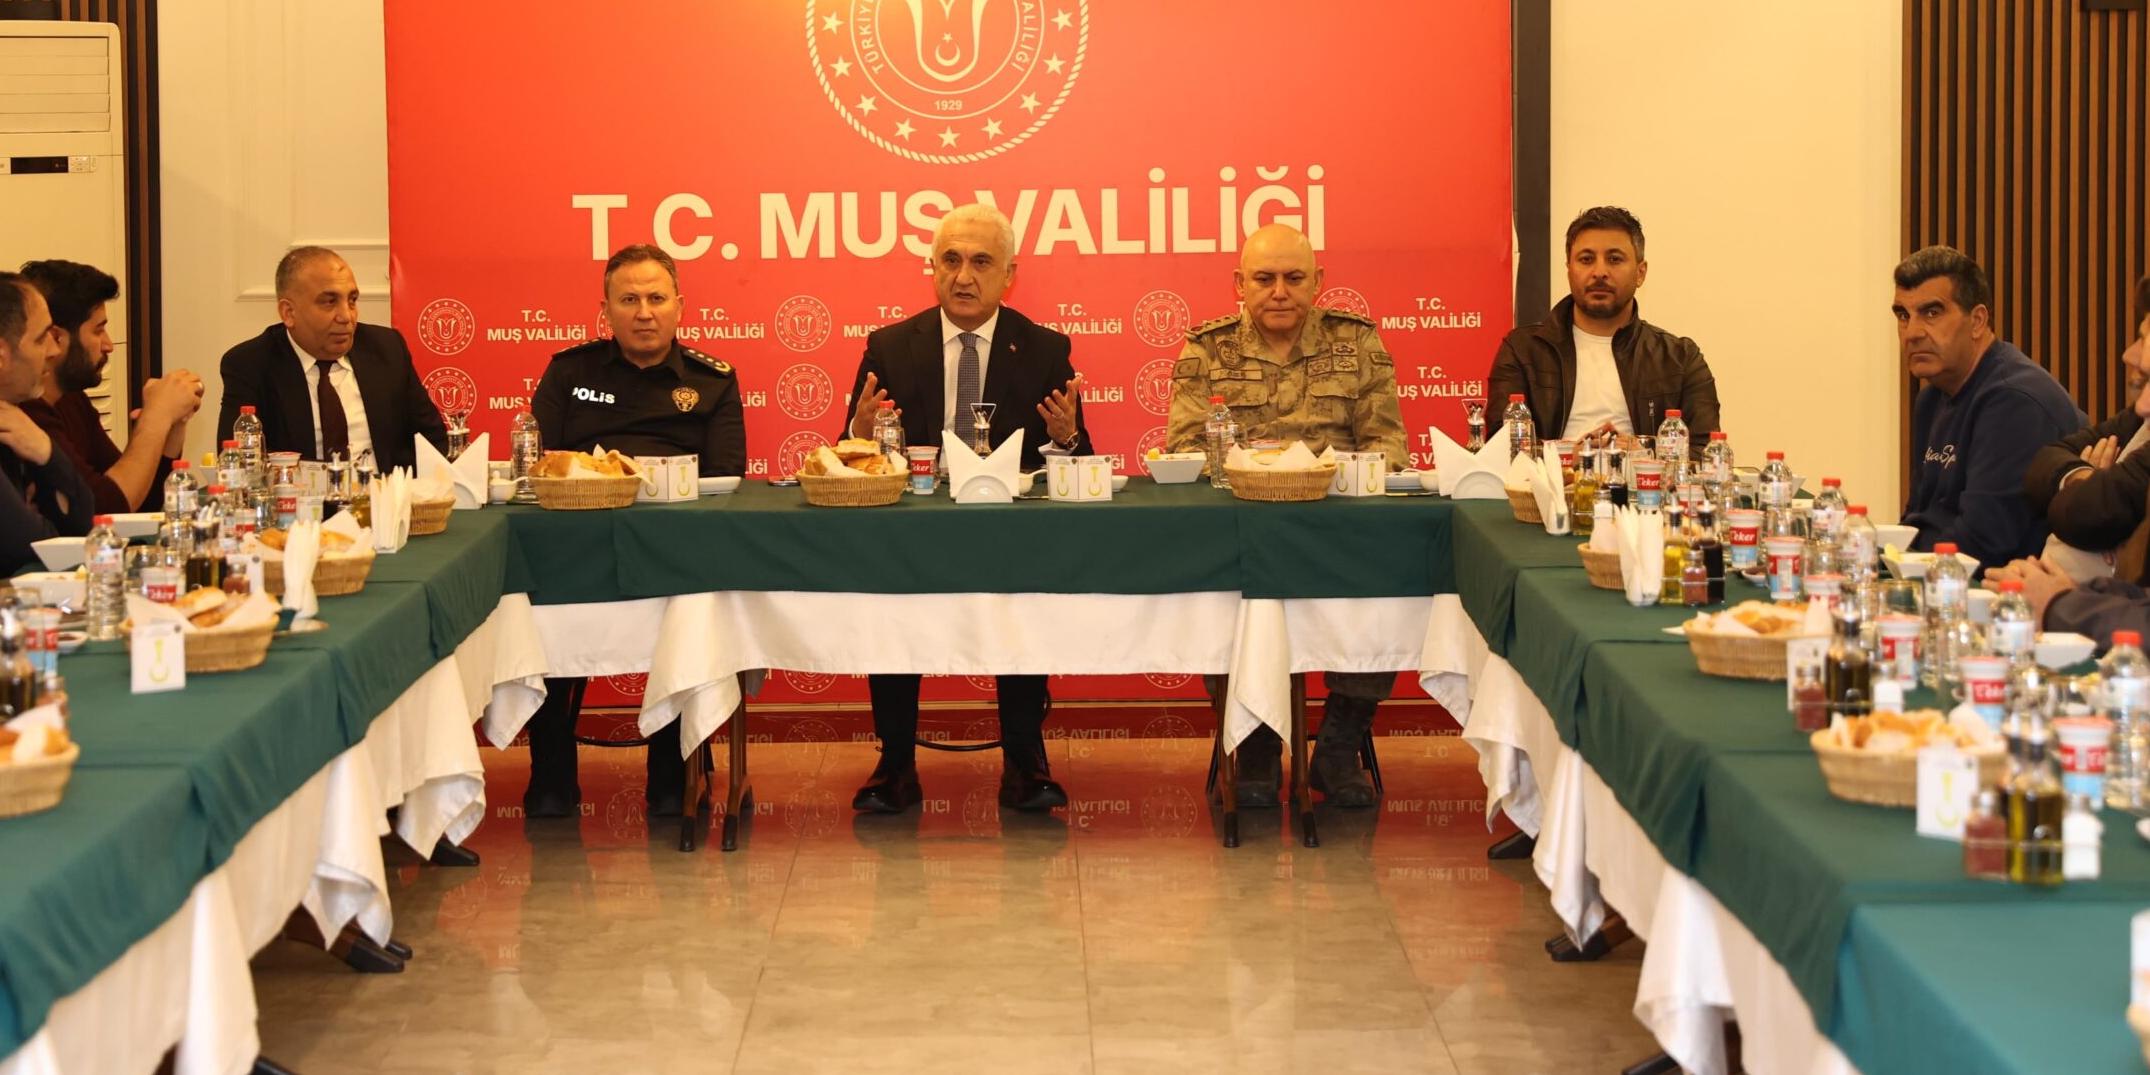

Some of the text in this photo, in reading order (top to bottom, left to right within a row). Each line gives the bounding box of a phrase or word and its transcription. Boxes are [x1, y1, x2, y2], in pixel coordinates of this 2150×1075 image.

[934, 99, 963, 111] 1929
[974, 164, 1325, 256] VALİLİĞİ
[1057, 303, 1087, 317] T.C.
[1416, 297, 1446, 311] T.C.
[521, 309, 551, 323] T.C.
[699, 307, 729, 321] T.C.
[877, 305, 907, 319] T.C.
[1060, 318, 1122, 335] VALİLİĞİ
[1381, 311, 1482, 332] MUŞ VALİLİĞİ
[486, 324, 587, 344] MUŞ VALİLİĞİ
[703, 322, 765, 340] VALİLİĞİ
[1417, 366, 1447, 379] T.C.
[1081, 386, 1124, 403] LİLİĞİ
[1397, 380, 1482, 401] UŞ VALİLİĞİ
